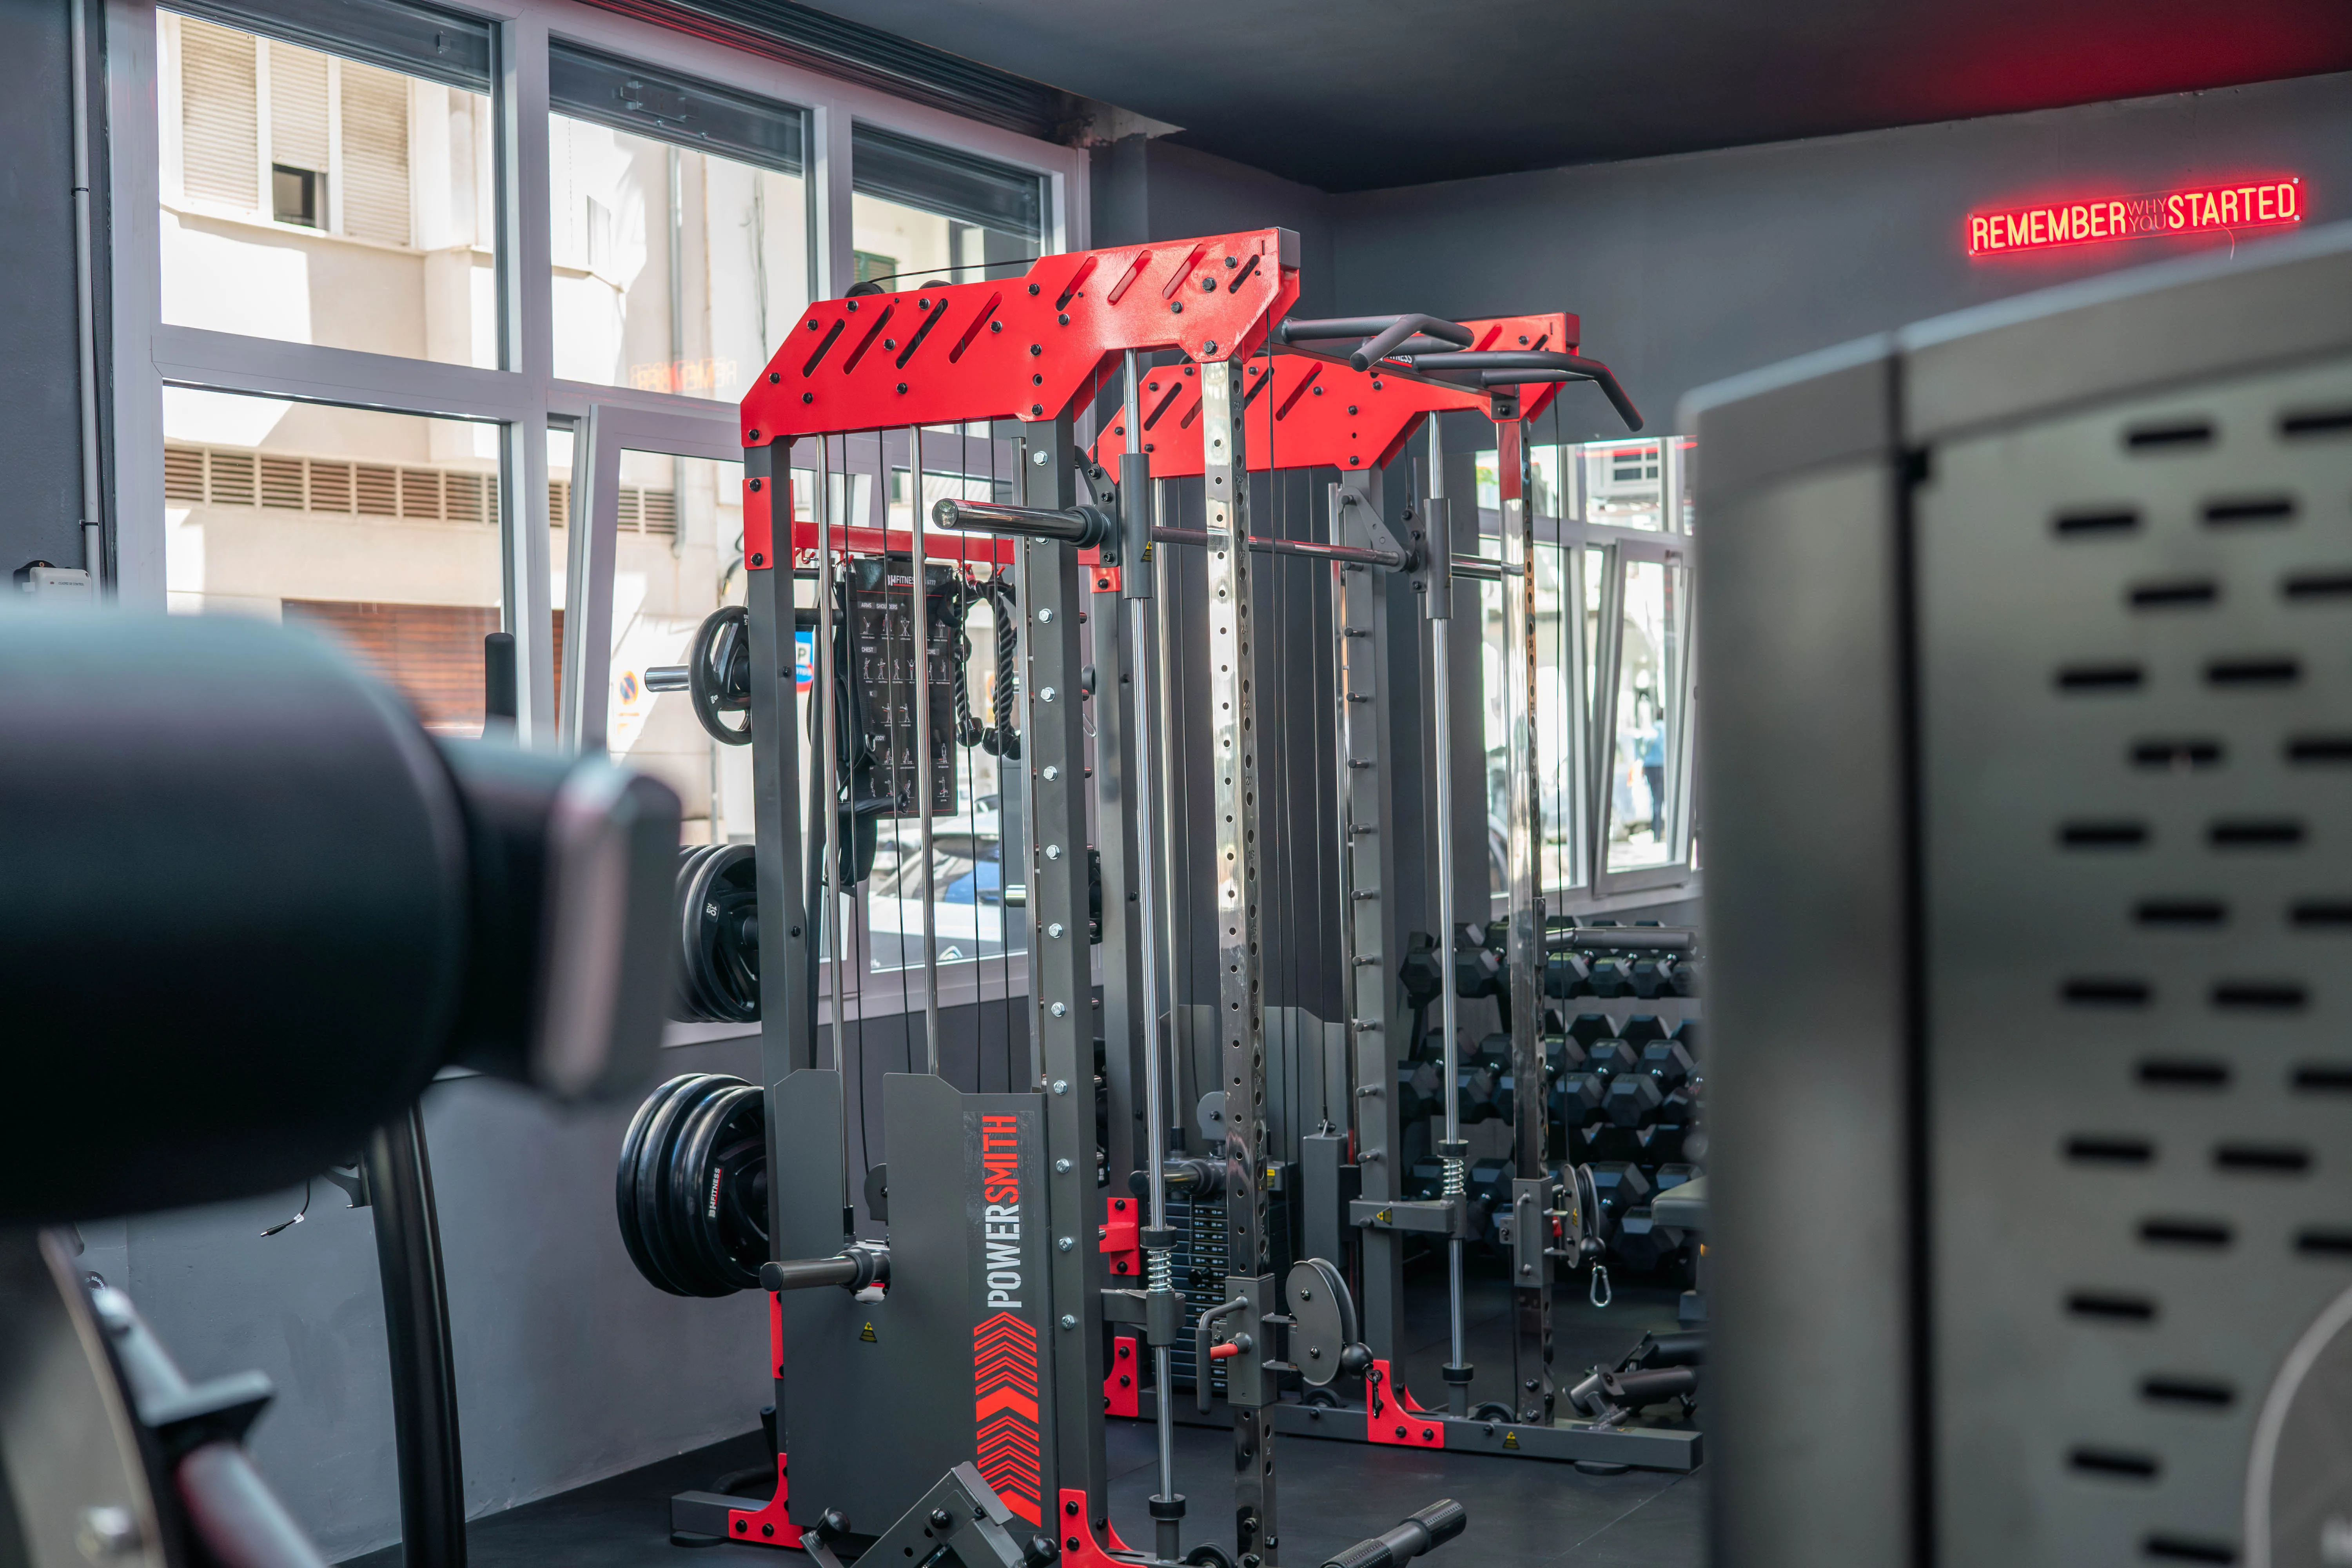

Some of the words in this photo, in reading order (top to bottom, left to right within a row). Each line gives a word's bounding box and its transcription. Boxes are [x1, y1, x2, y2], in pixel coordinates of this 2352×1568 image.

[1972, 201, 2126, 251] REMEMBER
[2126, 197, 2167, 216] WHY
[2168, 183, 2296, 229] STARTED
[2129, 213, 2167, 233] YOU
[1243, 699, 1250, 710] 22
[982, 1115, 1022, 1308] POWERSMITH
